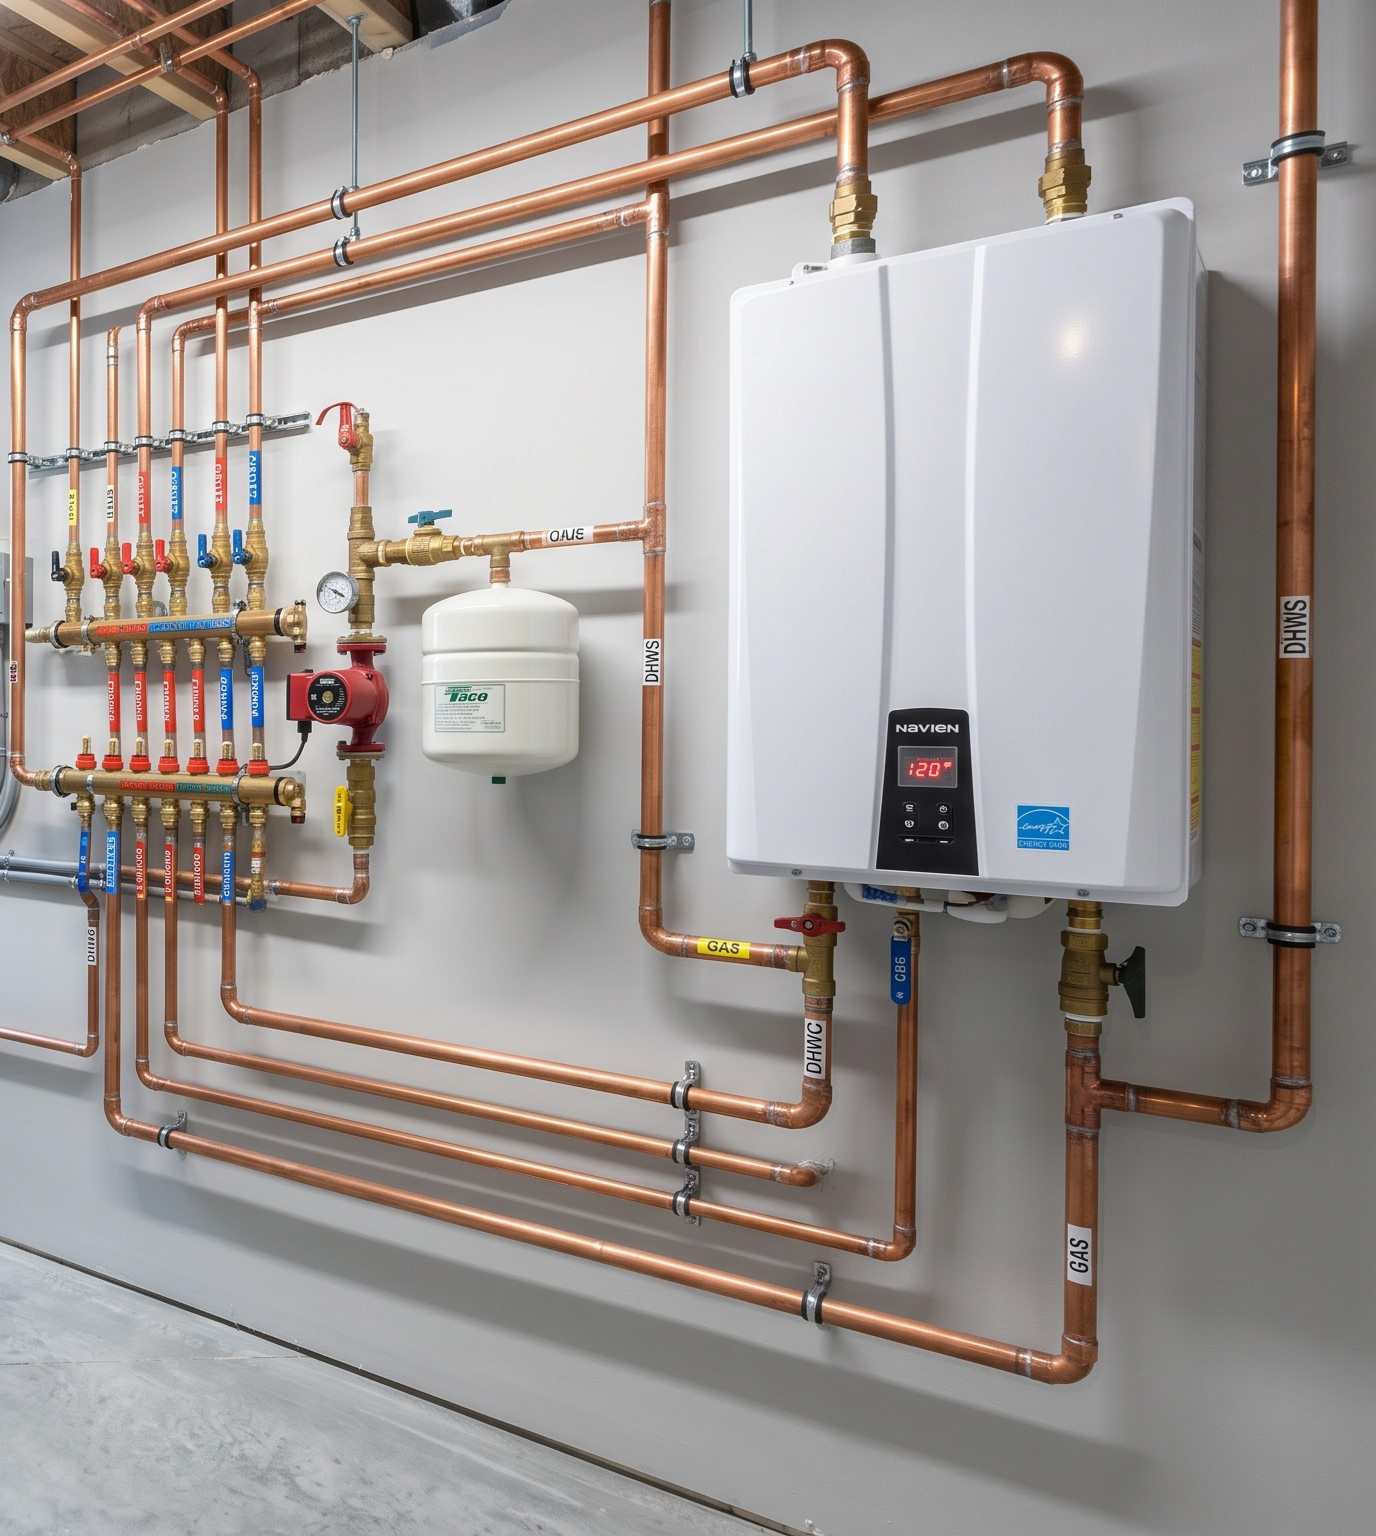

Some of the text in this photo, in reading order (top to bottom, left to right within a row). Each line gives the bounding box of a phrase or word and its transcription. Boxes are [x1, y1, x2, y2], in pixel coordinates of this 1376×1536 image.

[1283, 599, 1307, 654] DHWS
[645, 640, 660, 682] DHWS
[707, 940, 740, 954] GAS
[806, 1022, 823, 1075] DHWC
[1069, 1237, 1089, 1273] GAS
